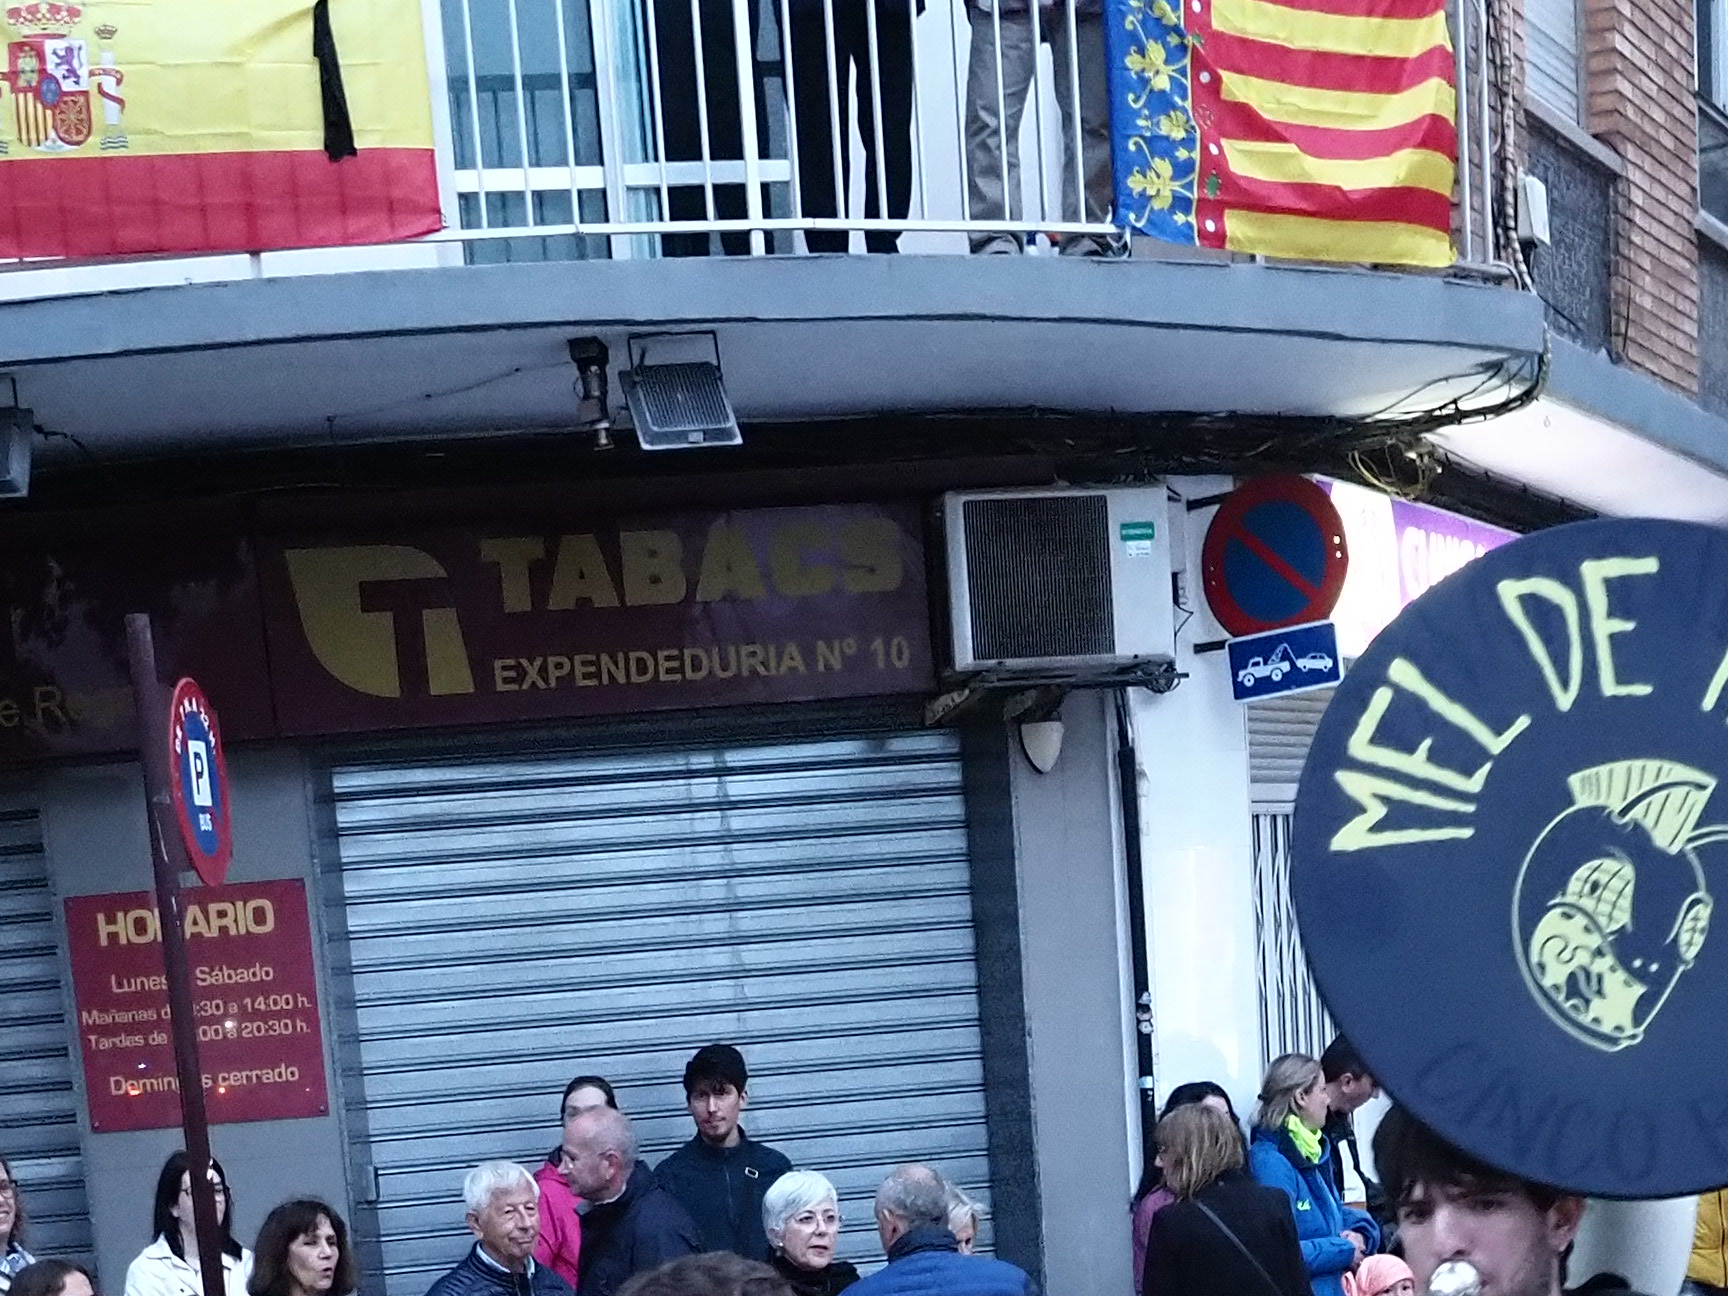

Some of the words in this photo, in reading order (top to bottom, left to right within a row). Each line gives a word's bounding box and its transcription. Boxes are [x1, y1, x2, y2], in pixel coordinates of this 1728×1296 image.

[480, 517, 903, 613] TABACS
[494, 643, 806, 692] EXPENDEDURIA
[874, 634, 910, 671] 10
[1331, 658, 1531, 850] MEL
[1498, 556, 1659, 712] DE
[196, 963, 274, 986] Sábado
[82, 1006, 158, 1027] Mañanas
[228, 1001, 238, 1013] a
[243, 995, 293, 1012] 14:00
[88, 1030, 144, 1050] Tardes
[149, 1030, 168, 1046] de
[242, 1020, 293, 1038] 20:30
[218, 1064, 299, 1087] cerrado
